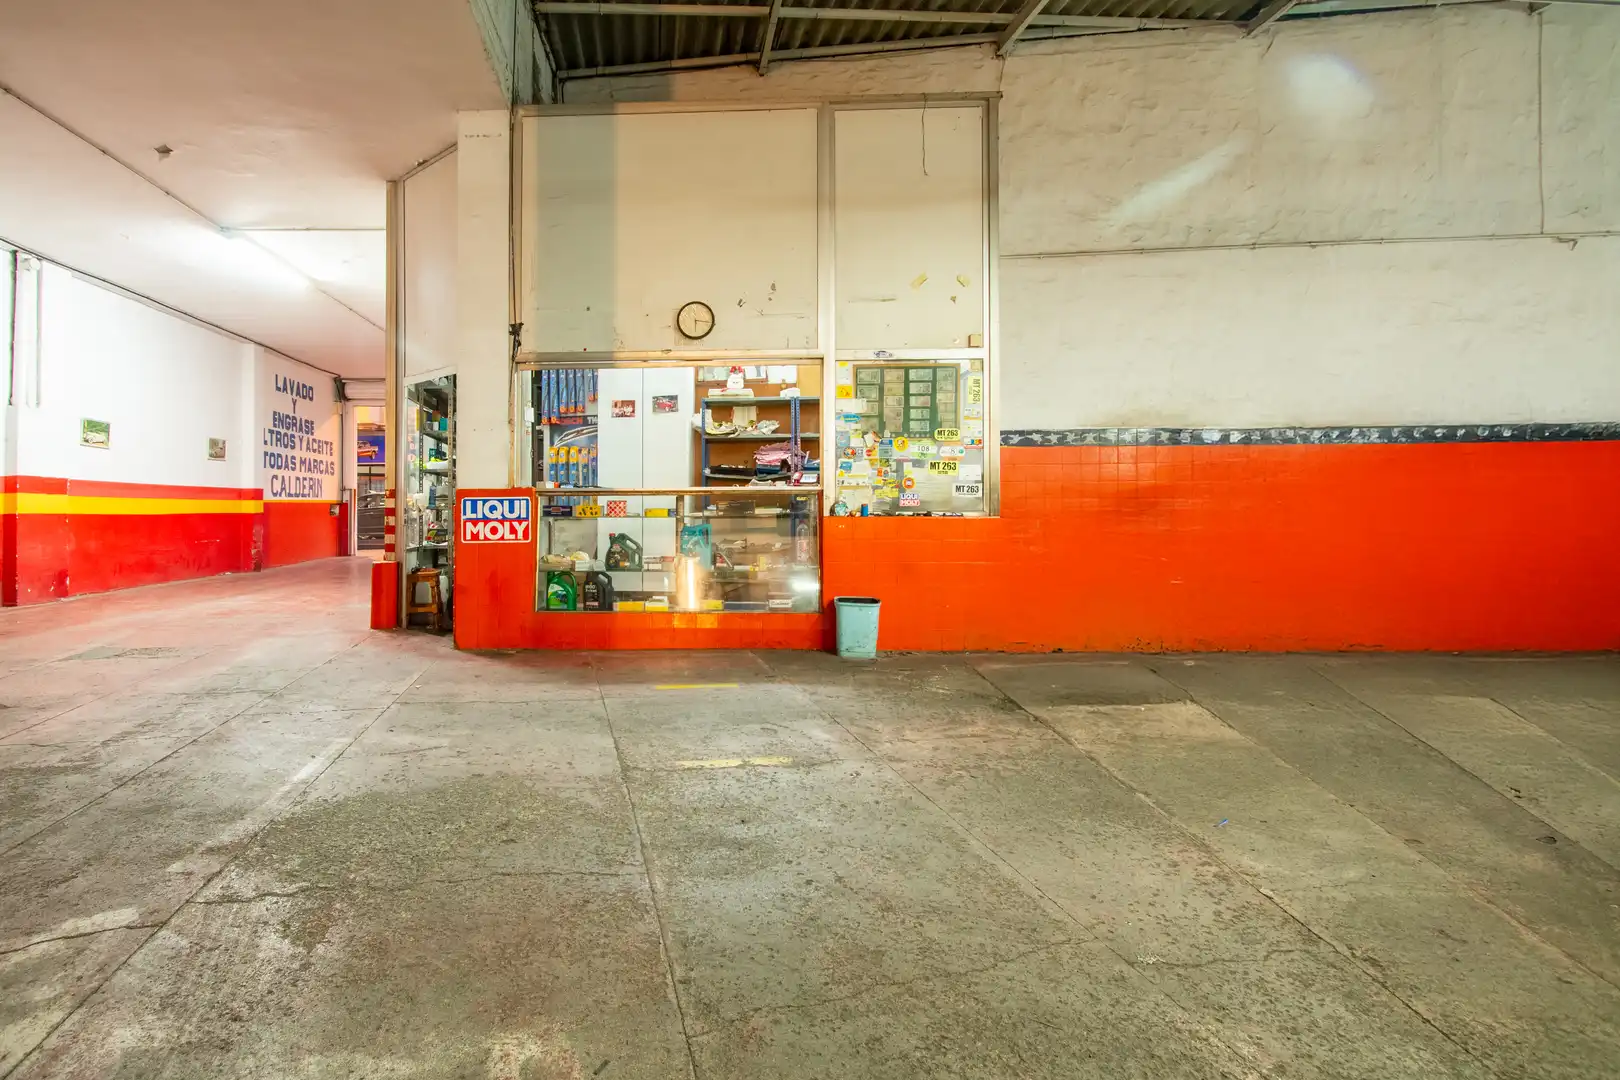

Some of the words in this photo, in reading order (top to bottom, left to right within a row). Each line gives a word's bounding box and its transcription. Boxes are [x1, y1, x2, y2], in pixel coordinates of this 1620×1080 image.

[275, 374, 314, 401] LAVADO
[291, 399, 297, 414] Y
[272, 410, 315, 436] ENGRASE
[937, 429, 946, 437] MT
[947, 429, 958, 437] 263
[298, 435, 304, 451] Y
[305, 437, 334, 456] ACEITE
[263, 451, 297, 472] TODAS
[299, 456, 335, 476] MARCAS
[929, 461, 941, 470] MT
[942, 461, 957, 471] 263
[955, 485, 965, 493] MT
[966, 485, 979, 494] 263
[463, 500, 527, 519] LIQUI
[465, 521, 529, 540] MOLY
